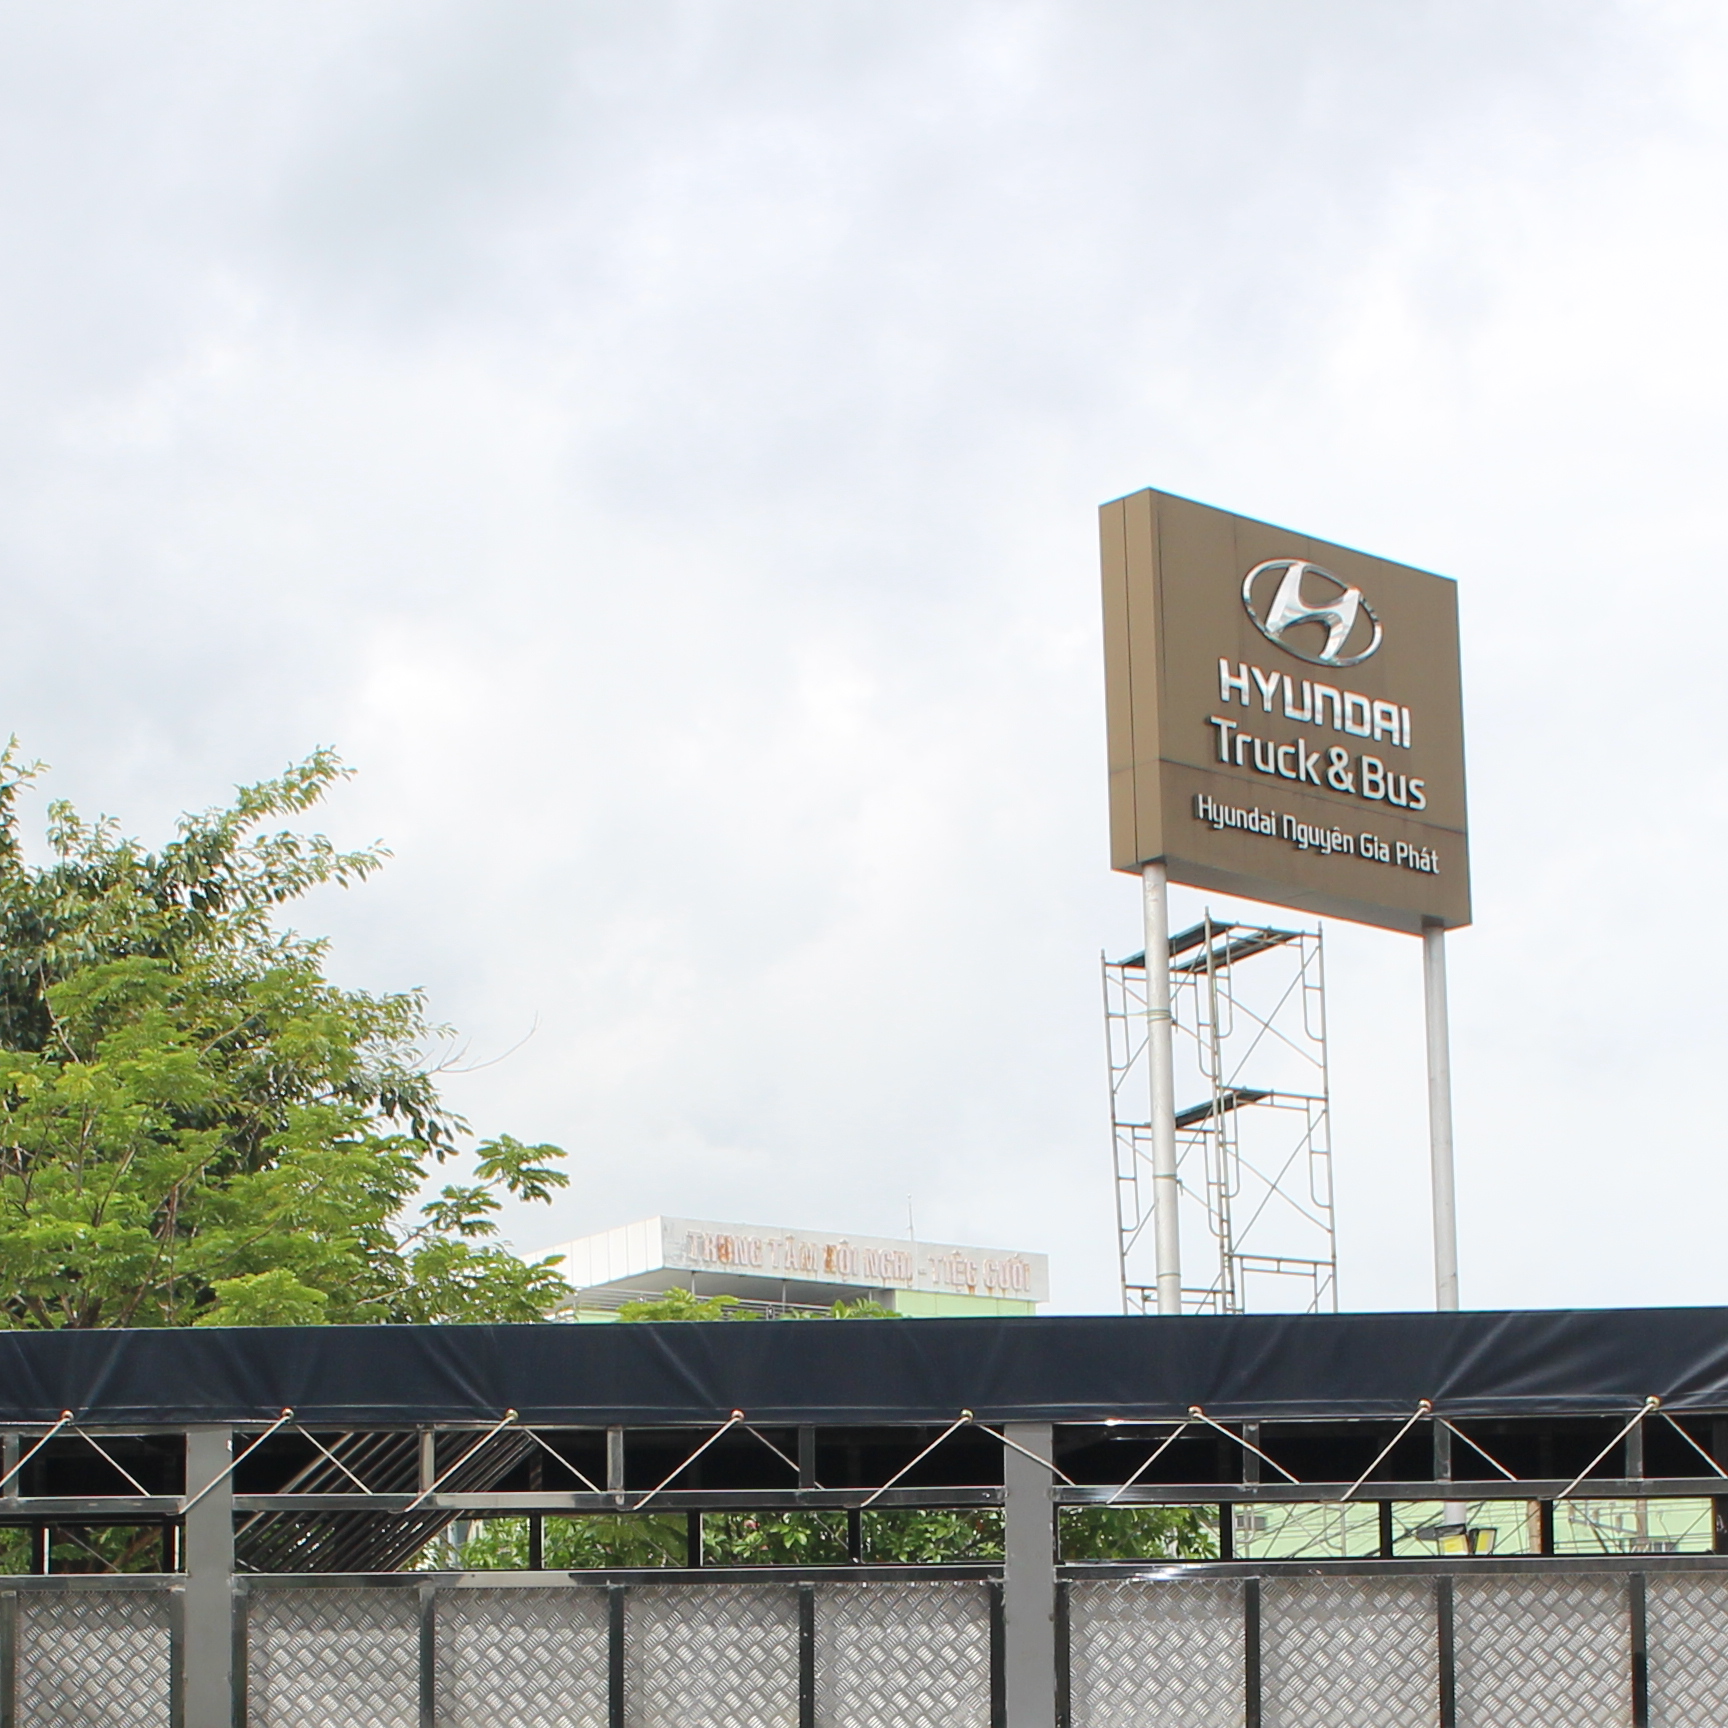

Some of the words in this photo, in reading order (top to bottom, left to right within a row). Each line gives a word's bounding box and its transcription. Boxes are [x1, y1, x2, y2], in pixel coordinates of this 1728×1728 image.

[1219, 658, 1412, 749] HYUNDAI
[1210, 715, 1322, 786] Truck
[1327, 745, 1356, 794] &
[1361, 754, 1427, 811] Bus
[1197, 793, 1277, 836] Hyundai
[1282, 813, 1355, 855] Nguyên
[1360, 832, 1391, 863] Gia
[1396, 840, 1440, 874] Phát
[767, 1233, 819, 1272] TÂM
